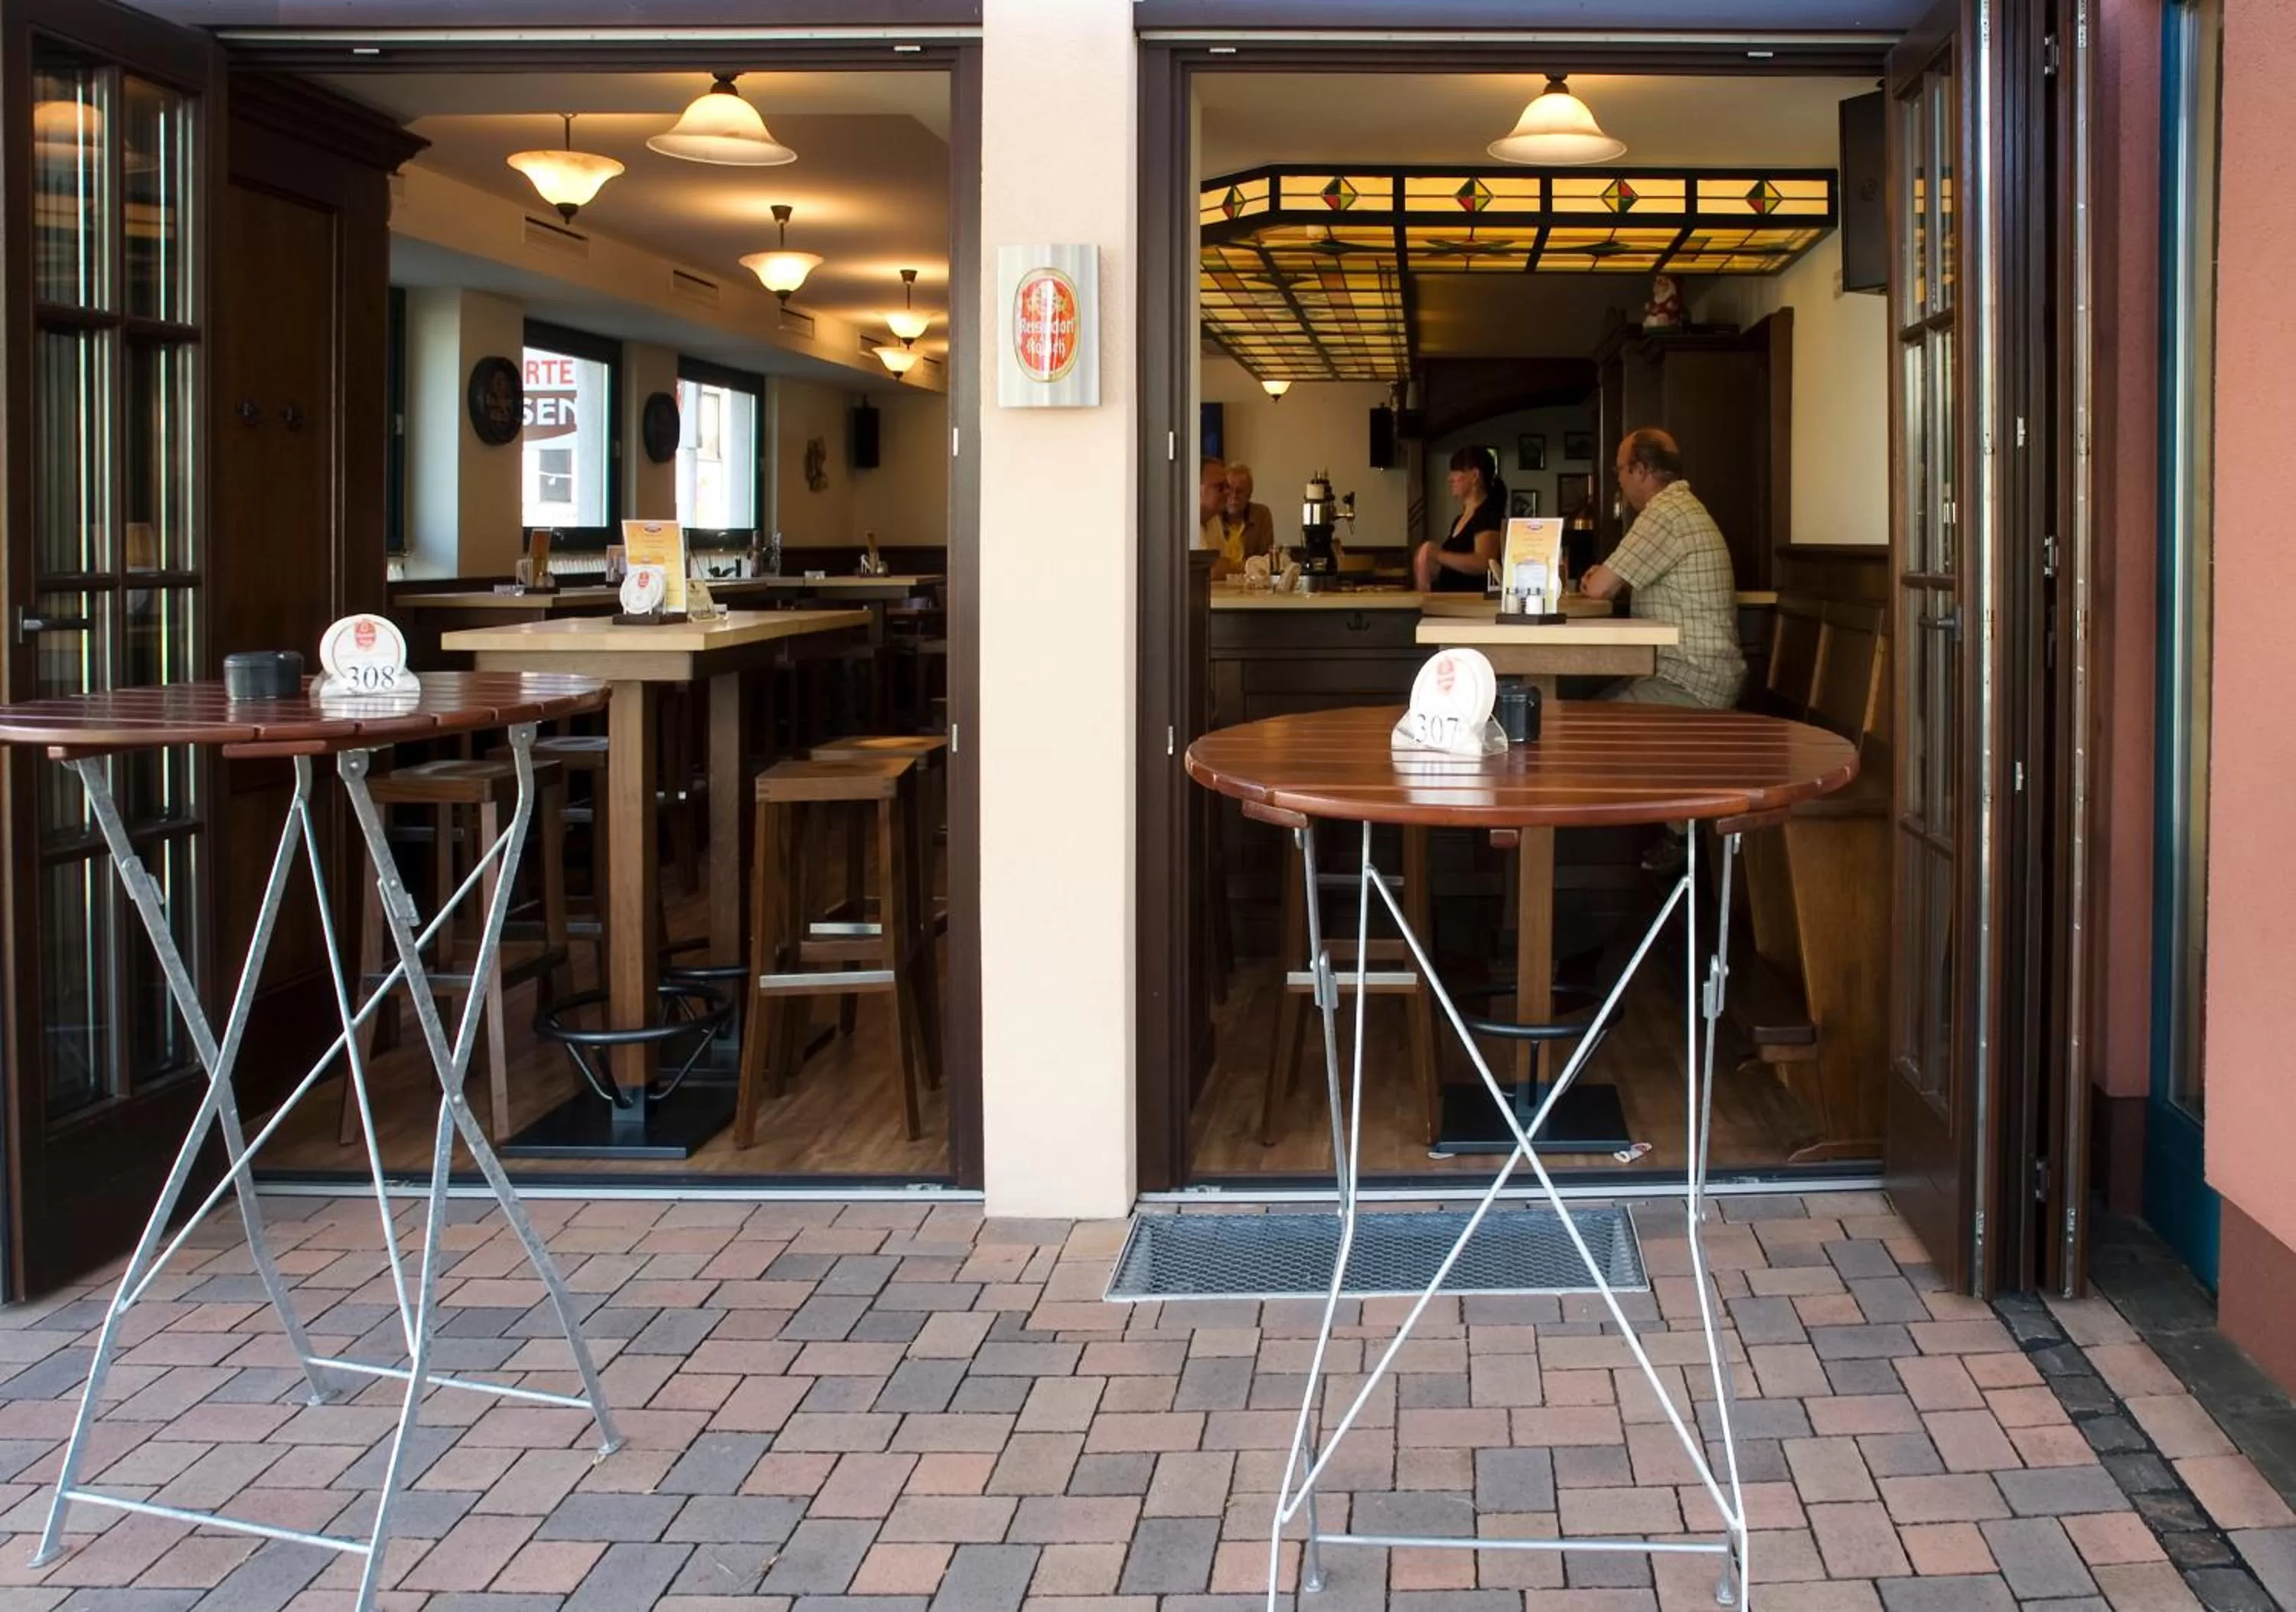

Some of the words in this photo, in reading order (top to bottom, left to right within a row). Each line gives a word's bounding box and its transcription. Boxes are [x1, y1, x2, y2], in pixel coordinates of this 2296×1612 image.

[525, 360, 575, 384] RTE
[347, 665, 395, 690] 308
[1414, 713, 1459, 749] 307
